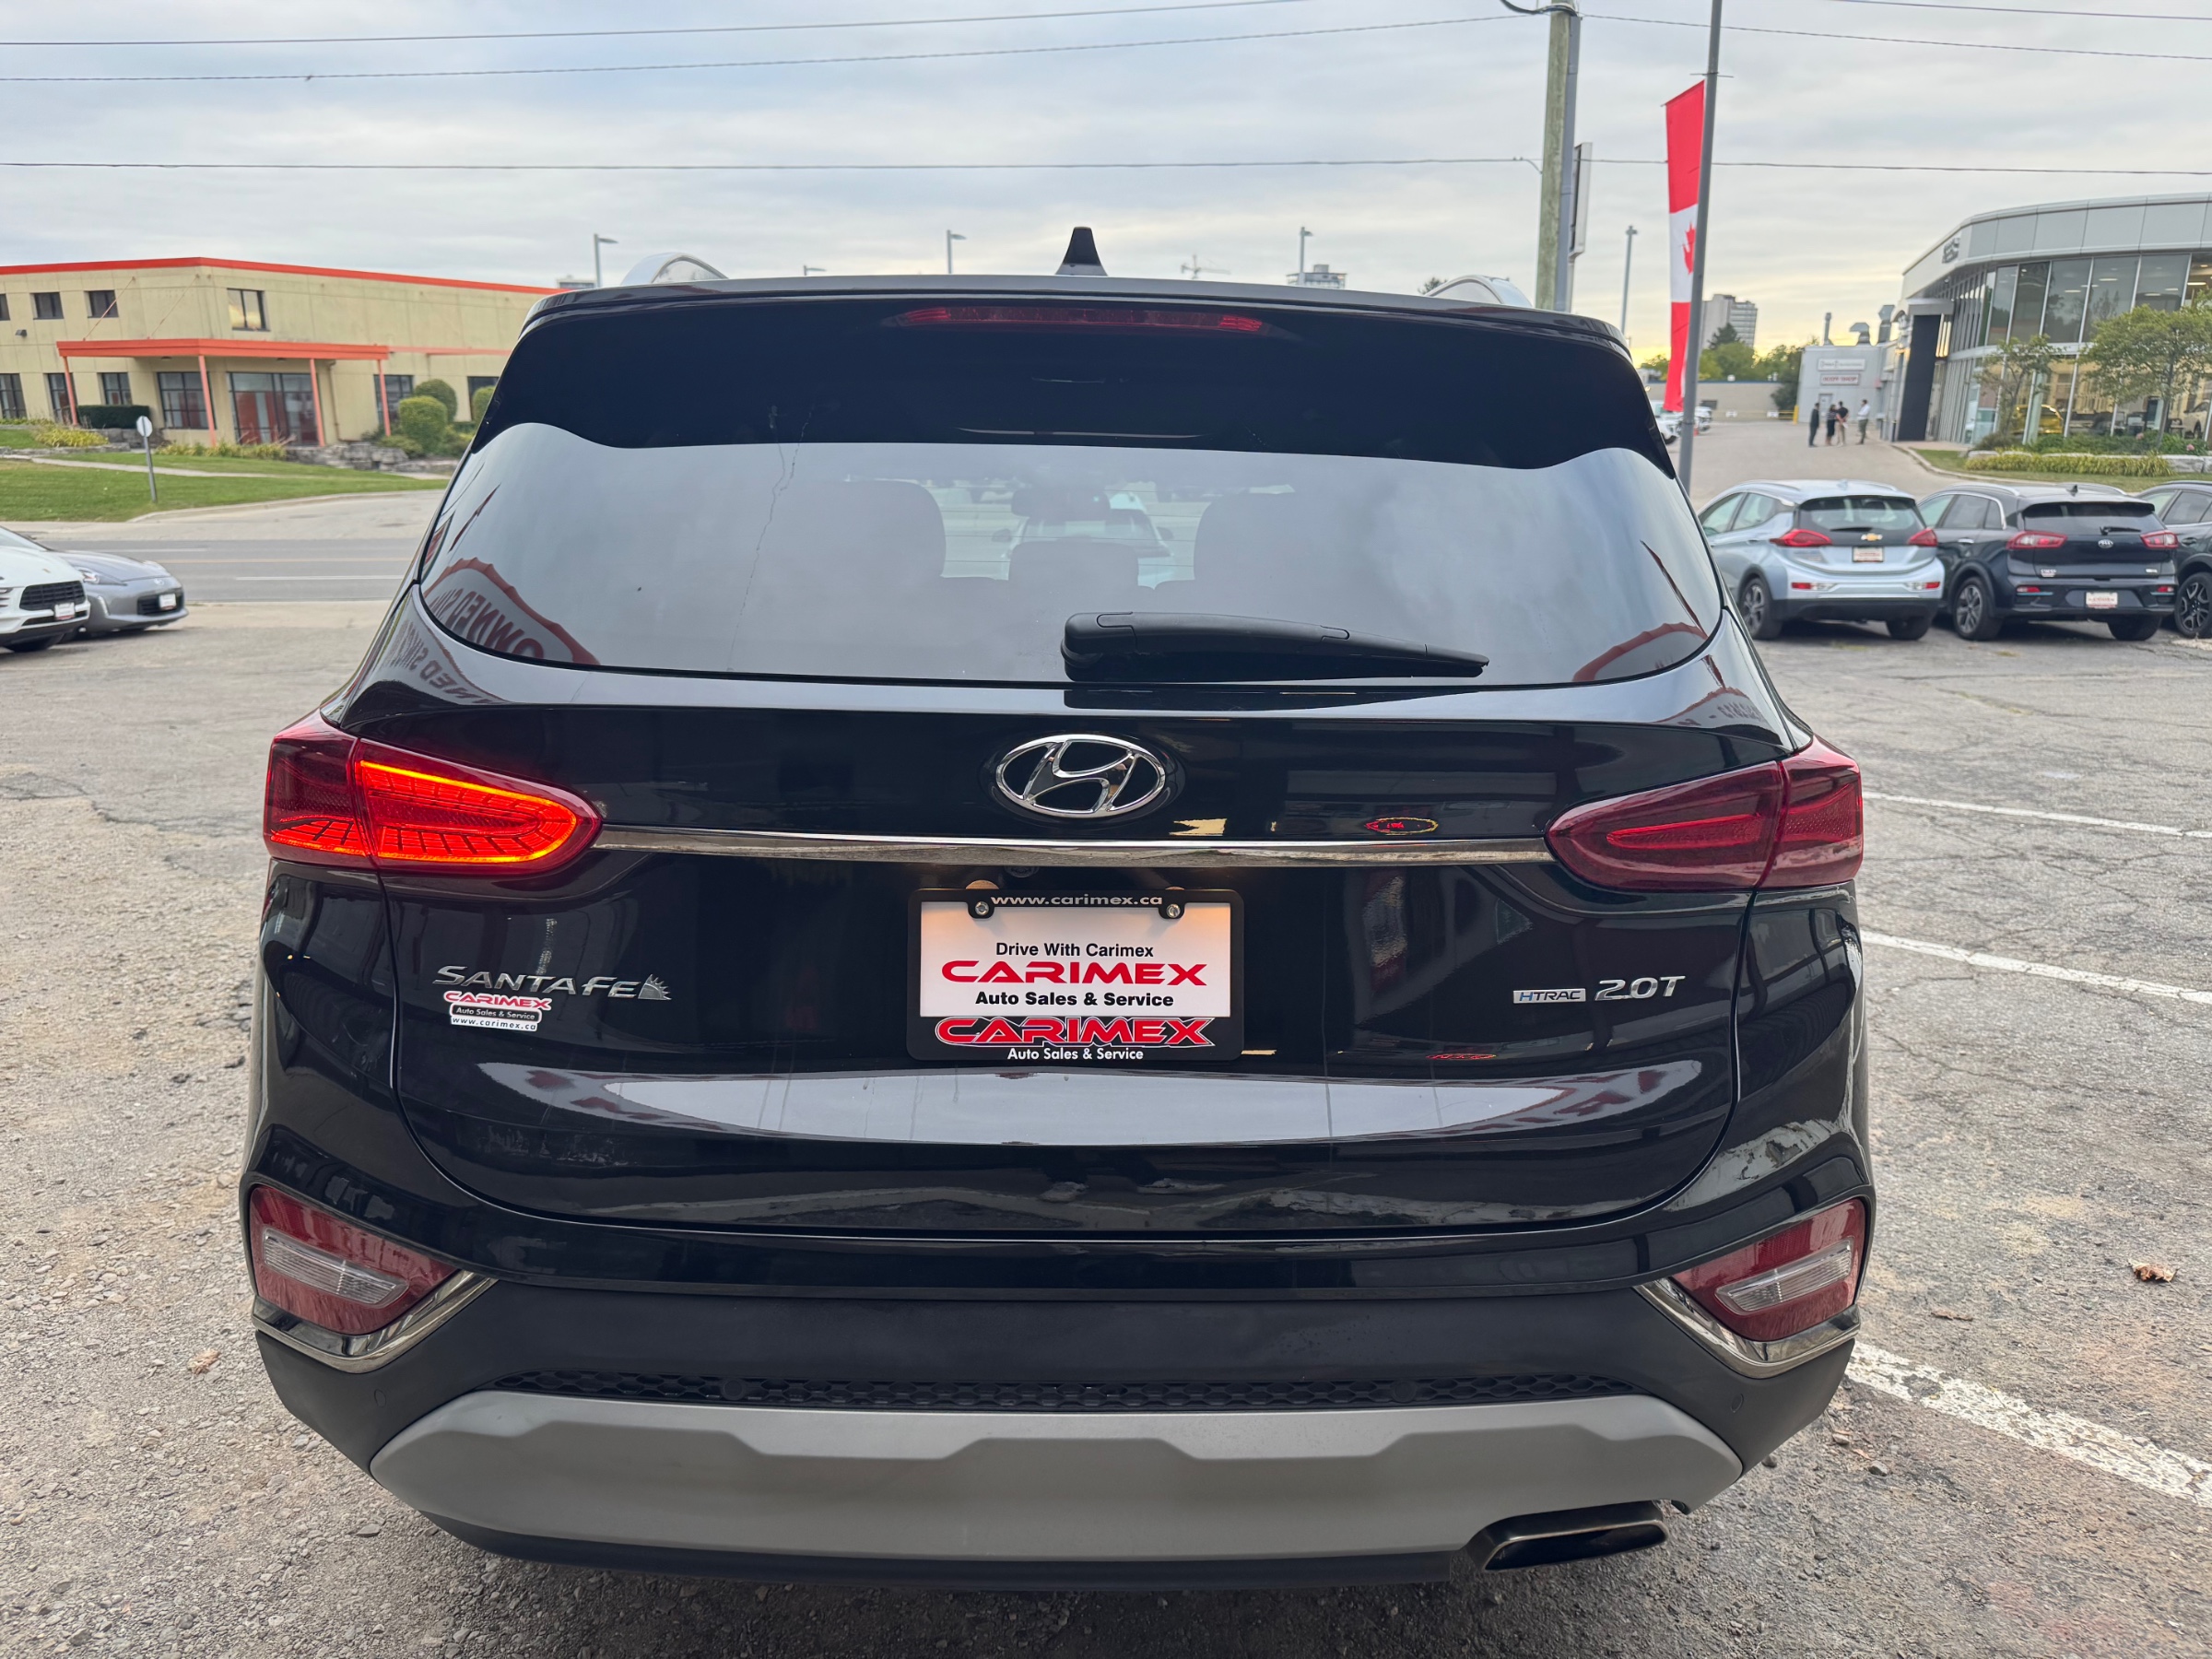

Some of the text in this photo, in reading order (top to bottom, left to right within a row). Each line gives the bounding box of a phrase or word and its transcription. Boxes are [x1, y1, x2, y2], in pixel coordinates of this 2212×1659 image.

[991, 894, 1162, 906] www.carimex.ca
[995, 942, 1154, 958] Drive With Carimex
[941, 960, 1207, 986] CARIMEX
[444, 992, 551, 1009] CARIMEX
[975, 992, 1174, 1007] Auto Sales & Service
[1519, 991, 1582, 1002] HTRAC
[455, 1006, 475, 1015] Auto
[476, 1008, 497, 1018] Sales
[507, 1011, 535, 1020] Service
[452, 1017, 536, 1030] www.carimex.ca
[936, 1018, 1213, 1045] CARIMEX
[1007, 1048, 1144, 1061] Auto Sales & Service
